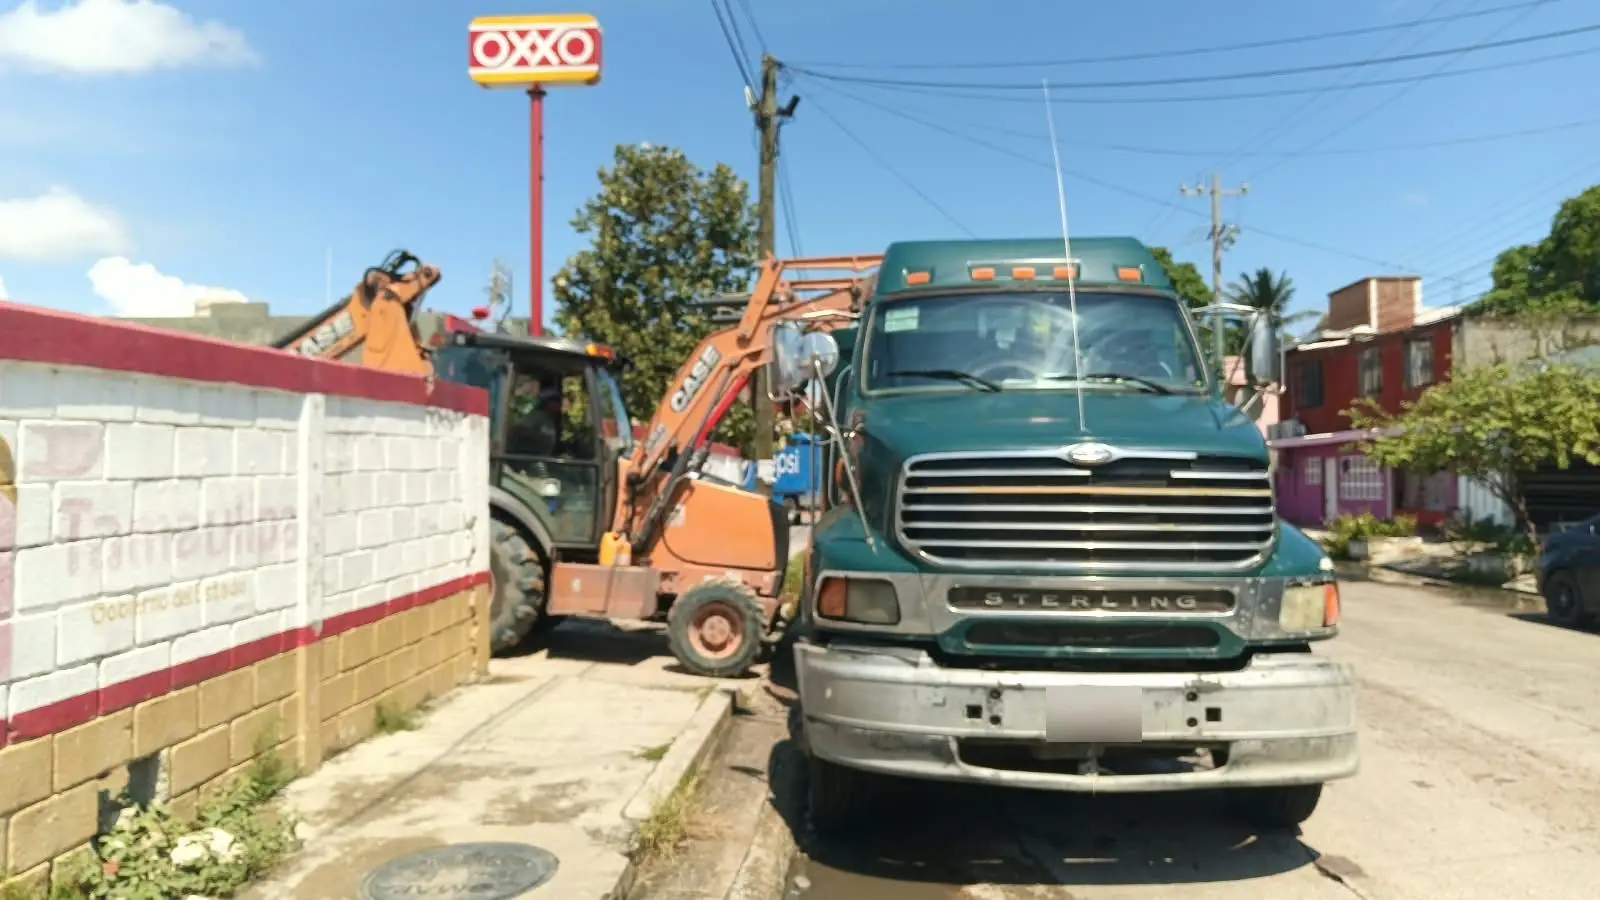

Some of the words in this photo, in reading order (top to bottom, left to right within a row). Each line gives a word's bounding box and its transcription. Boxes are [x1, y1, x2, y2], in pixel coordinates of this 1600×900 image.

[473, 30, 594, 69] OXXO
[288, 310, 352, 358] ASE
[671, 344, 720, 412] CASE
[984, 592, 1197, 609] STERLING
